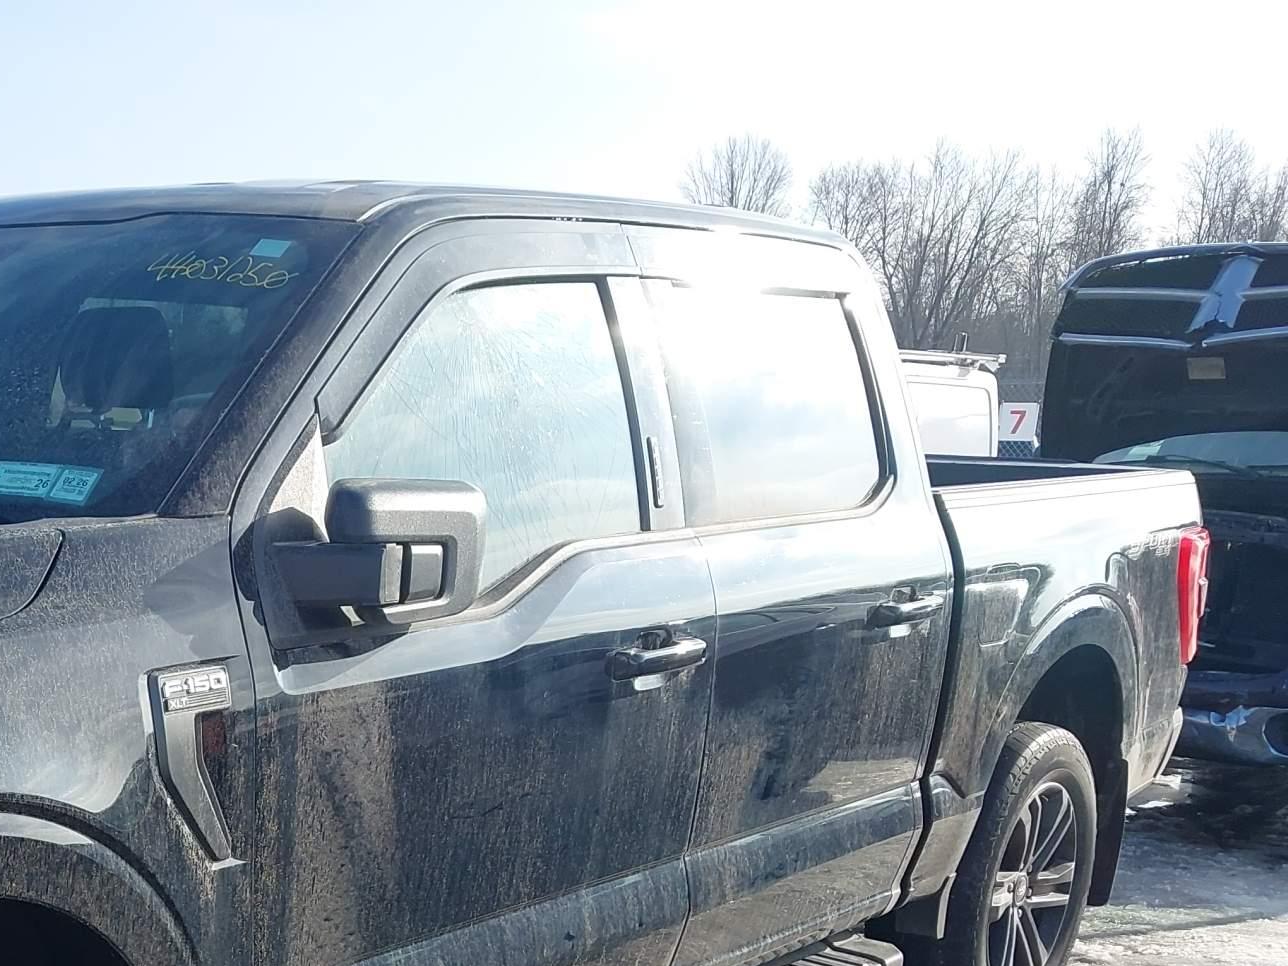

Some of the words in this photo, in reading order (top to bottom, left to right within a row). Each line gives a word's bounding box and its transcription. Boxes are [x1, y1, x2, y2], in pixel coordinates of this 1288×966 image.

[146, 250, 300, 289] 44031250
[1010, 410, 1027, 434] 7
[34, 479, 50, 489] 26
[76, 478, 89, 488] 26
[168, 698, 189, 711] XLT
